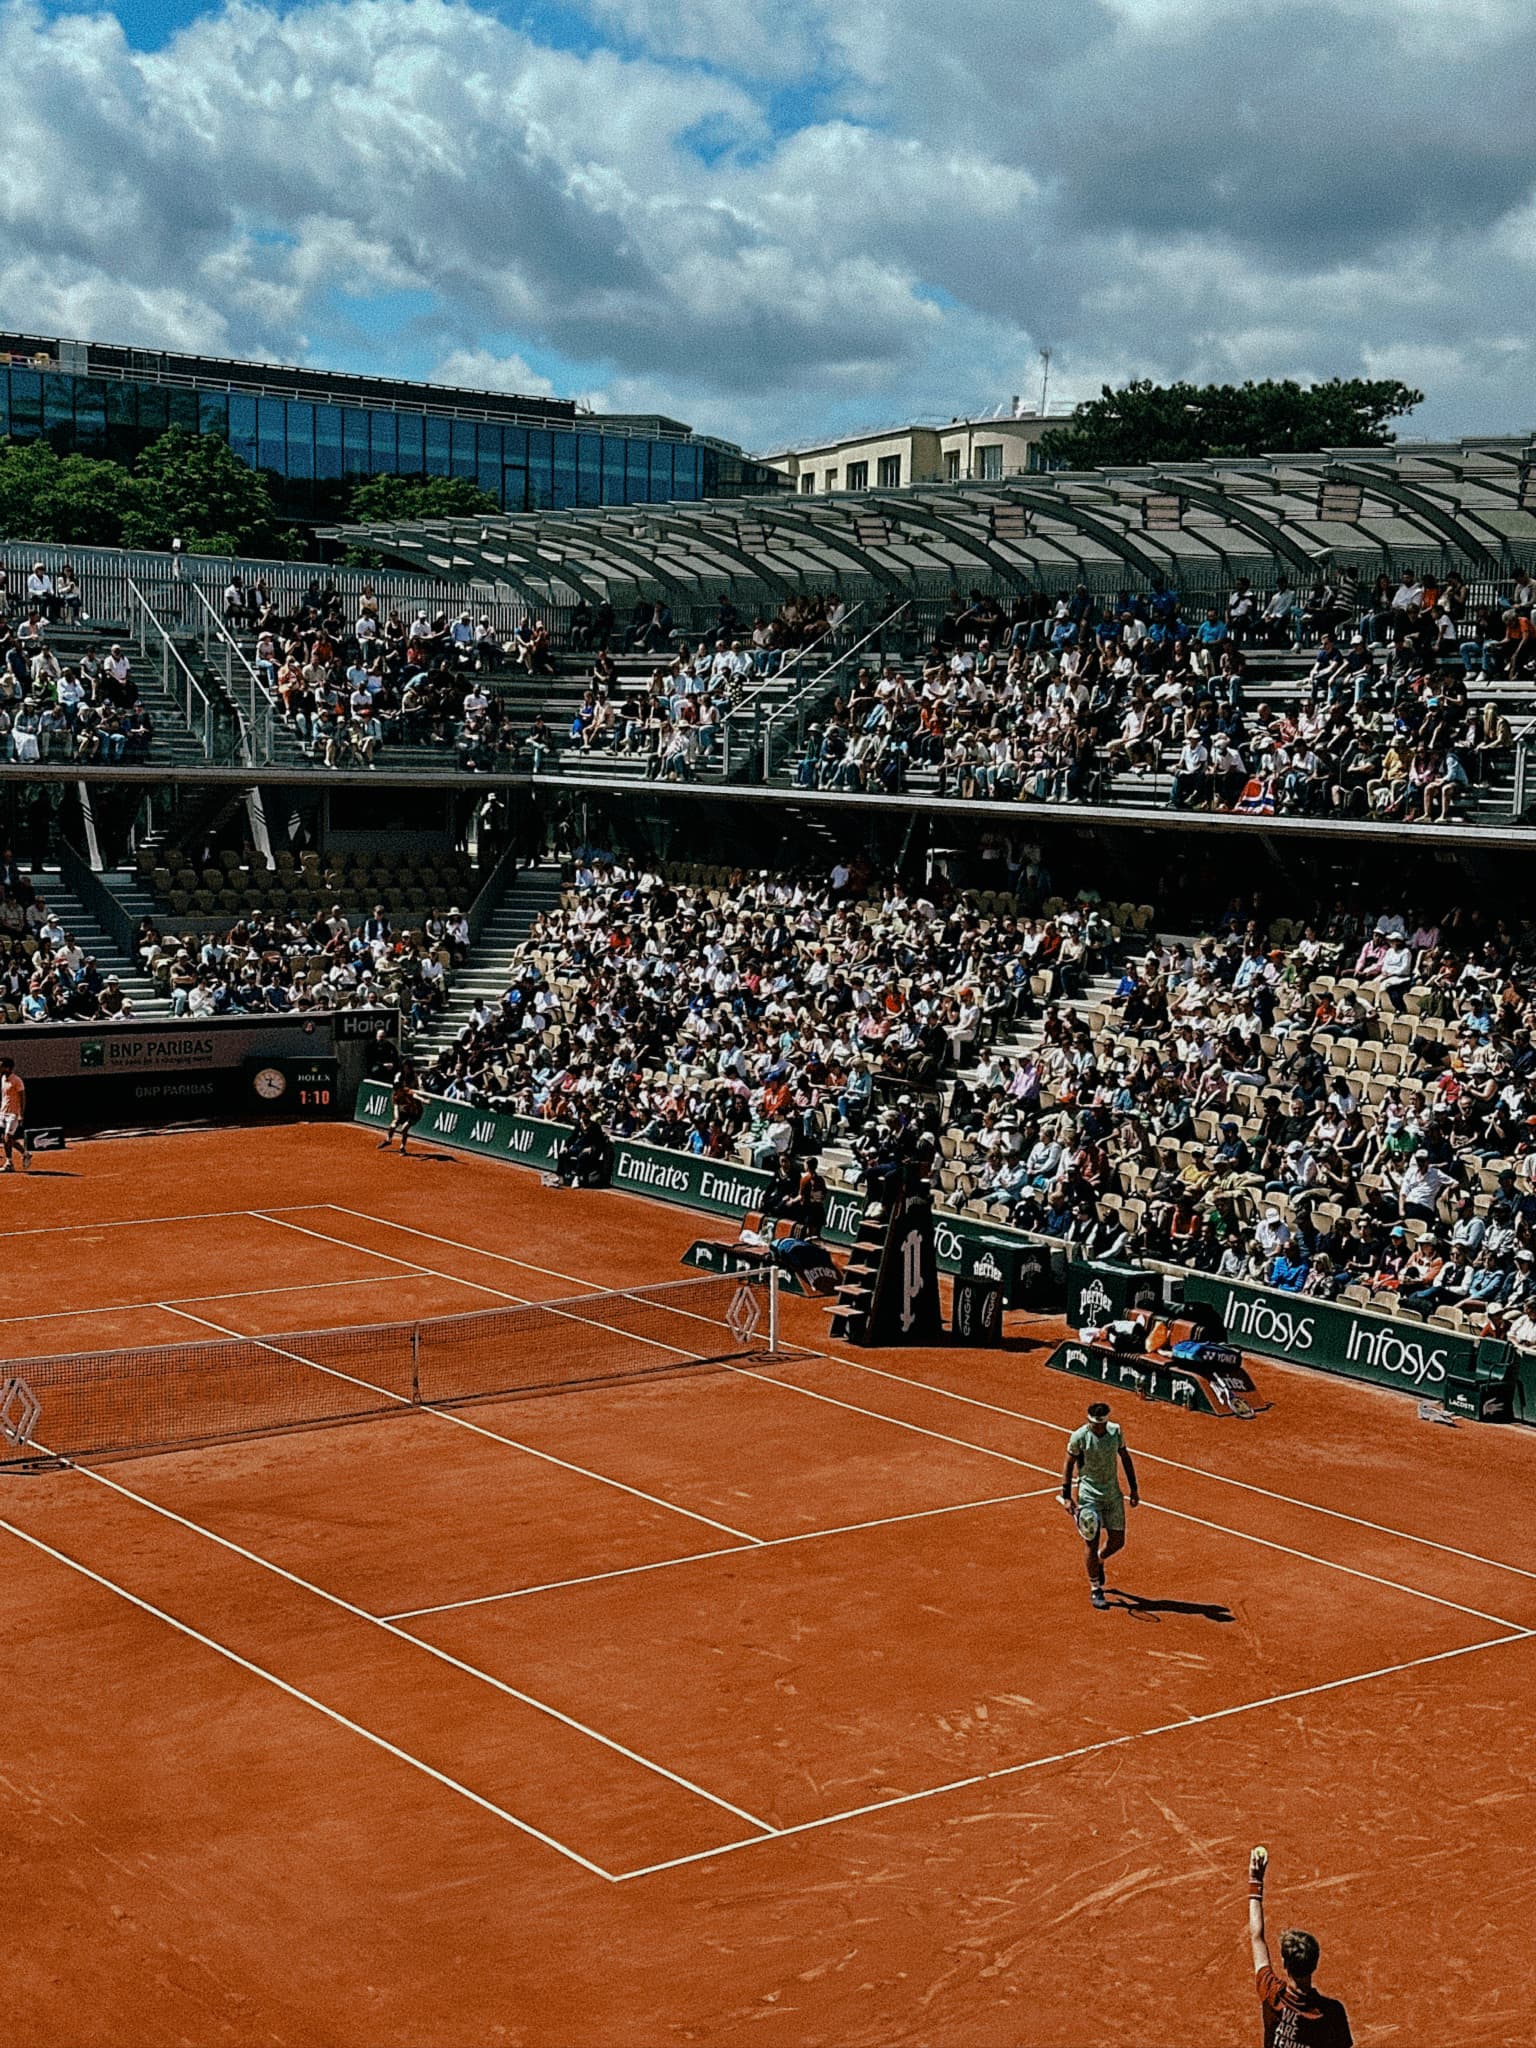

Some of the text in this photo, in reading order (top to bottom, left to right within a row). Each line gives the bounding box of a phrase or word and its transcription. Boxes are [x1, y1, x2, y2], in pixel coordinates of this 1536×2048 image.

[343, 1016, 392, 1034] Haier
[110, 1039, 213, 1058] BNP PARIBAS
[296, 1073, 331, 1082] ROLEX
[135, 1081, 215, 1098] BNP PARIBAS
[299, 1089, 331, 1106] 1:10
[616, 1151, 691, 1192] Emirates
[699, 1171, 767, 1210] Emirat
[825, 1195, 864, 1236] Info
[1223, 1290, 1316, 1353] Infosys
[1345, 1319, 1449, 1386] Infosys
[1448, 1398, 1475, 1412] LACOSTE
[1281, 2007, 1300, 2027] WE
[1275, 2020, 1301, 2041] ARE
